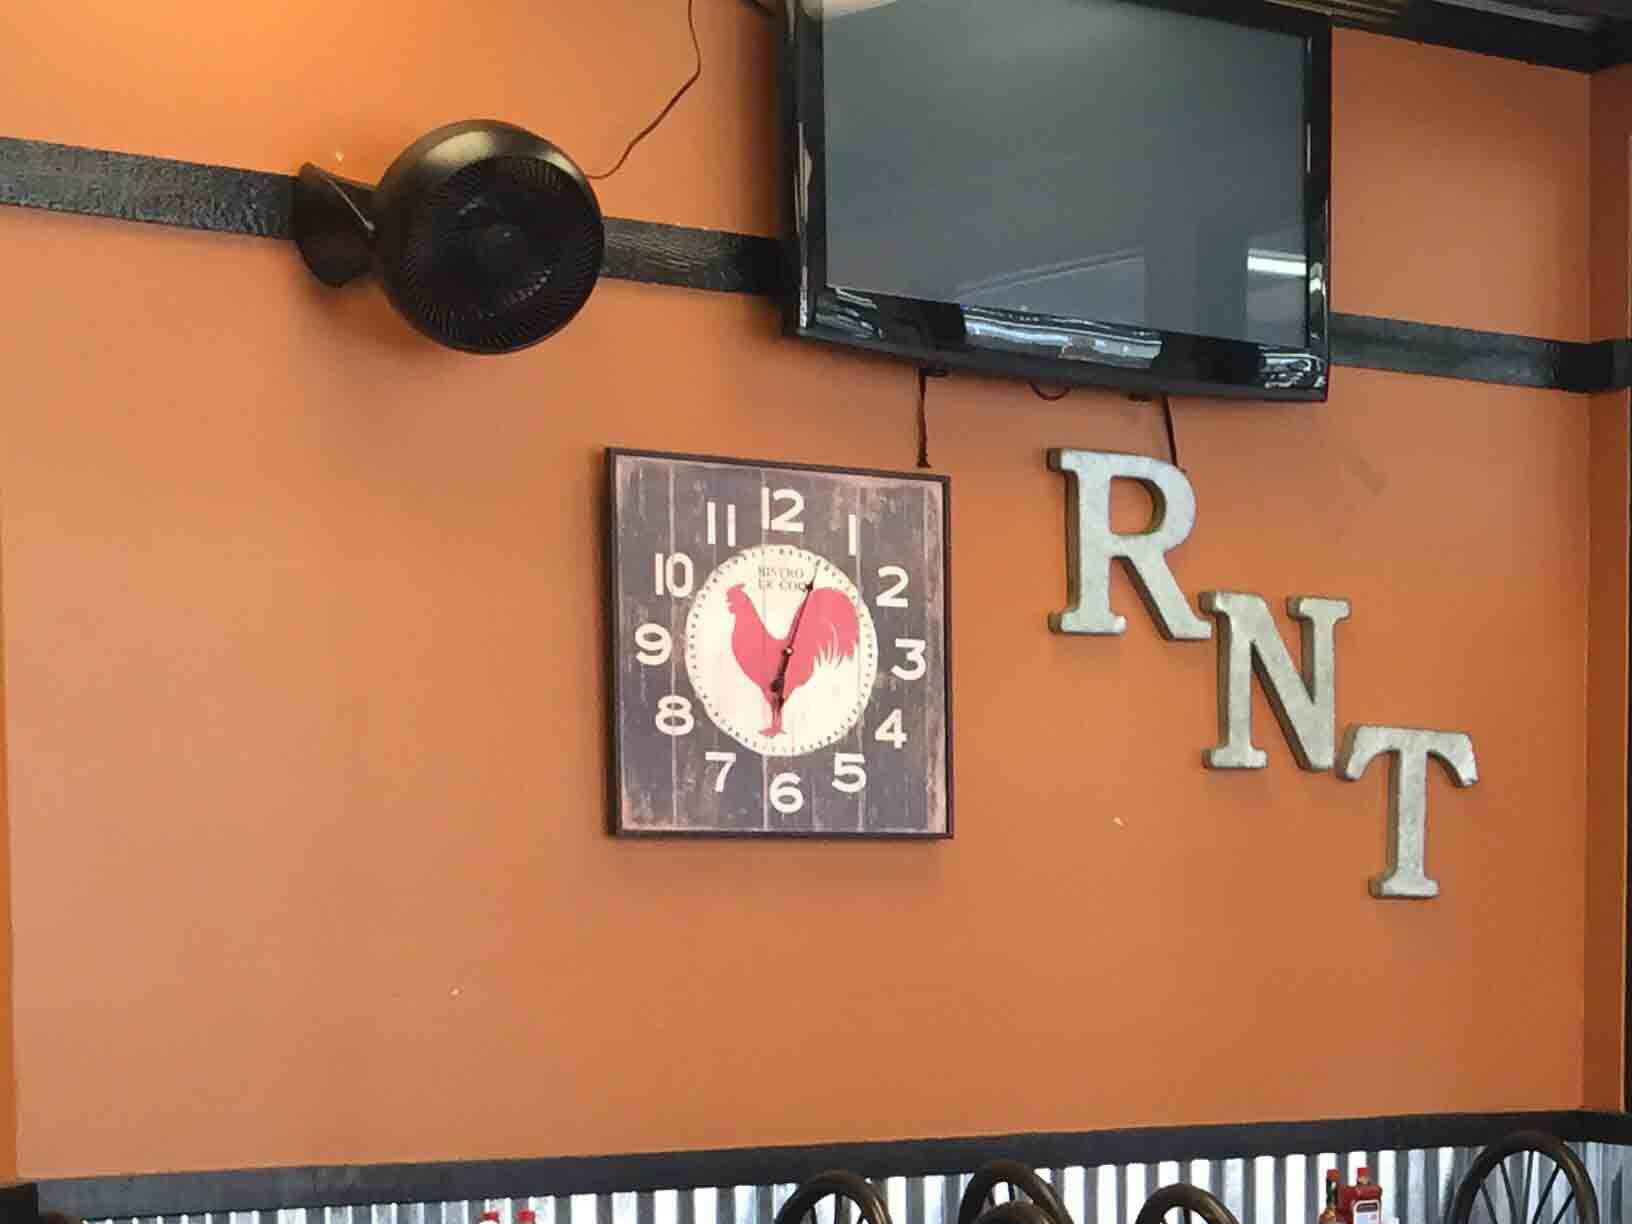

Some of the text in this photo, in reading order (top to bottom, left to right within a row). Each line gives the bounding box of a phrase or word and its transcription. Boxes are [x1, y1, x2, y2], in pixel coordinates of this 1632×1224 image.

[706, 501, 737, 547] 11
[760, 487, 805, 532] 12
[848, 514, 858, 556] 1
[655, 551, 694, 598] 10
[875, 565, 910, 608] 2
[634, 622, 673, 666] 9
[890, 637, 927, 681] 3
[654, 695, 695, 736] 8
[874, 708, 908, 749] 4
[704, 751, 737, 793] 7
[769, 772, 805, 814] 6
[831, 752, 868, 793] 5
